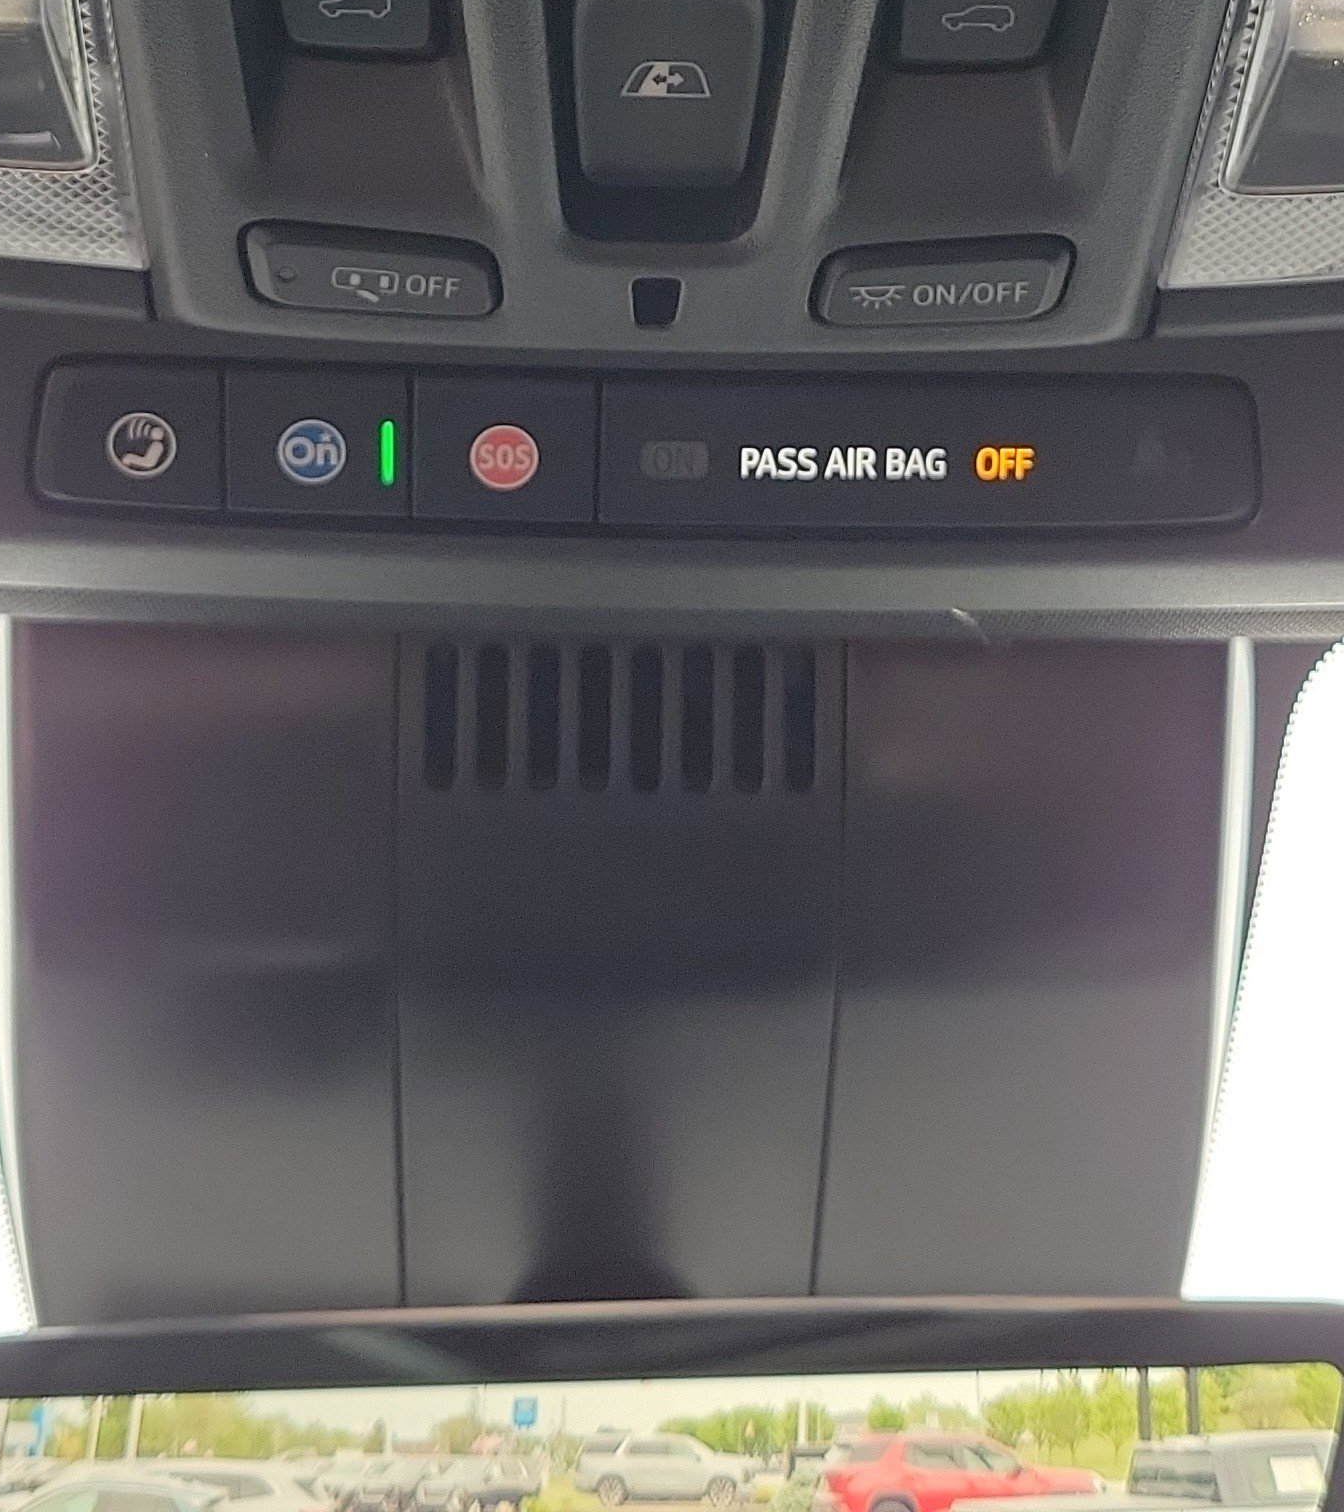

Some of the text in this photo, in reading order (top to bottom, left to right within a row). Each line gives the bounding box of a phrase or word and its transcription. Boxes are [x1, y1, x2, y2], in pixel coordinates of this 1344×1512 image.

[407, 276, 459, 296] OFF
[912, 281, 1030, 306] ON/OFF
[478, 444, 530, 469] SOS
[740, 447, 1036, 481] PASS AIR BAG OFF
